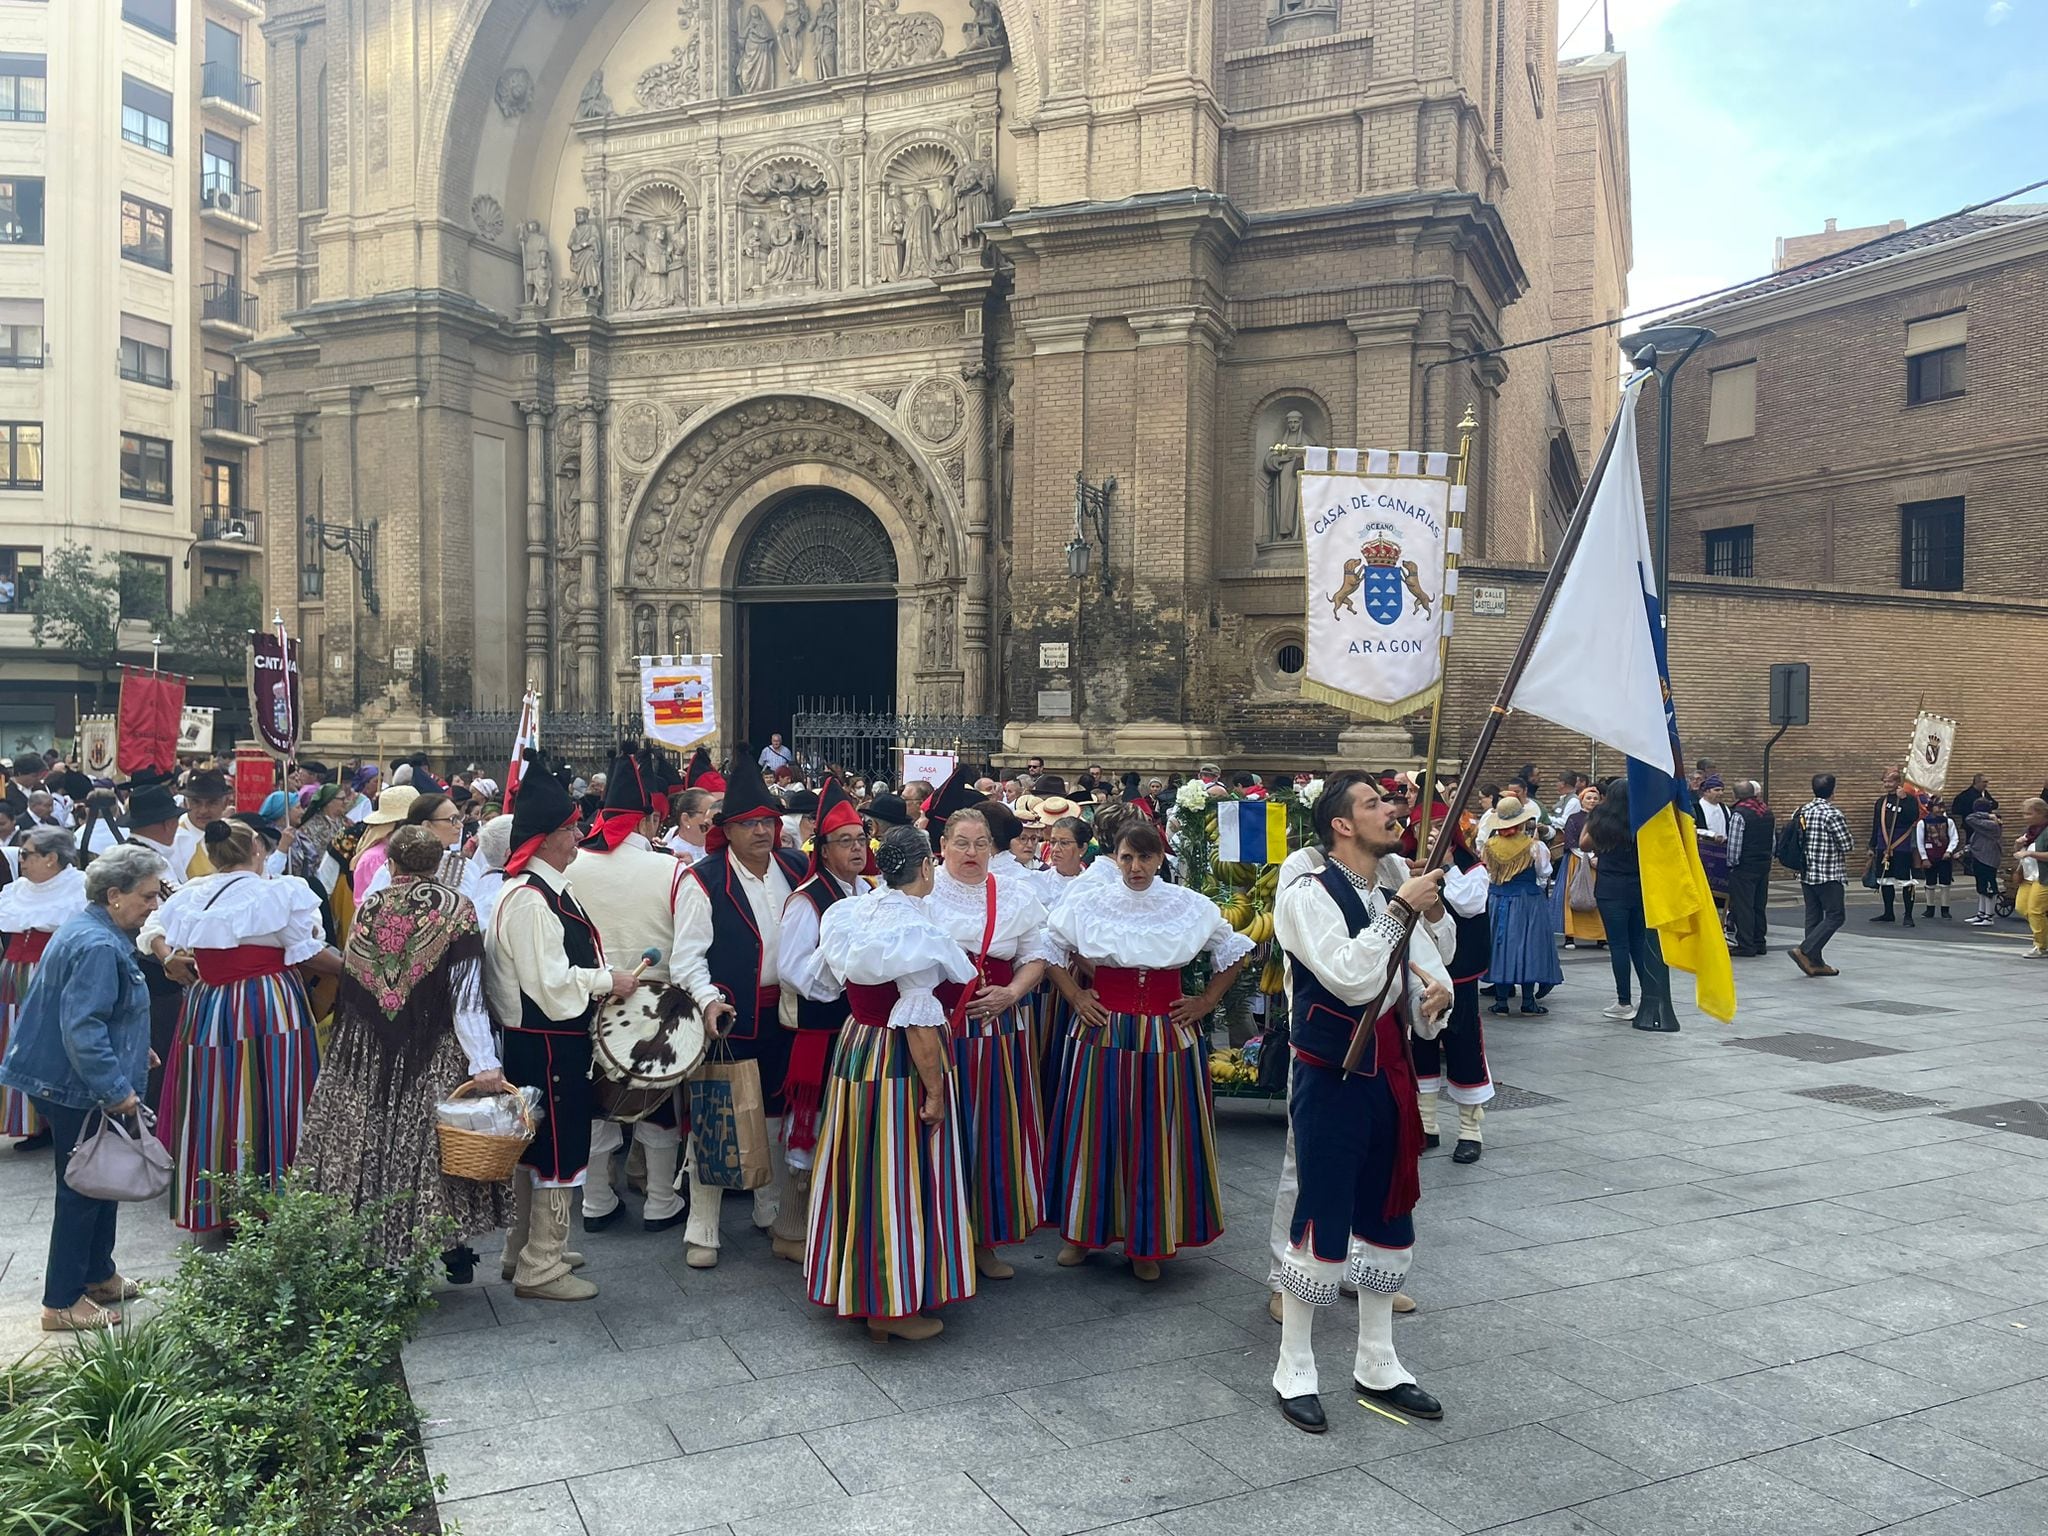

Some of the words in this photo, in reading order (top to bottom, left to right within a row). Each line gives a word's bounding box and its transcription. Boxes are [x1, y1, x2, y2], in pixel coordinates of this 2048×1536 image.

[1313, 504, 1347, 534] CASA
[1351, 494, 1370, 510] DE
[1377, 494, 1441, 539] CANARIAS
[1365, 522, 1395, 532] OCEANO
[1484, 591, 1503, 599] CALLE
[1474, 600, 1505, 610] CASTELLANO
[1348, 639, 1423, 654] ARAGON
[918, 766, 937, 774] CASA
